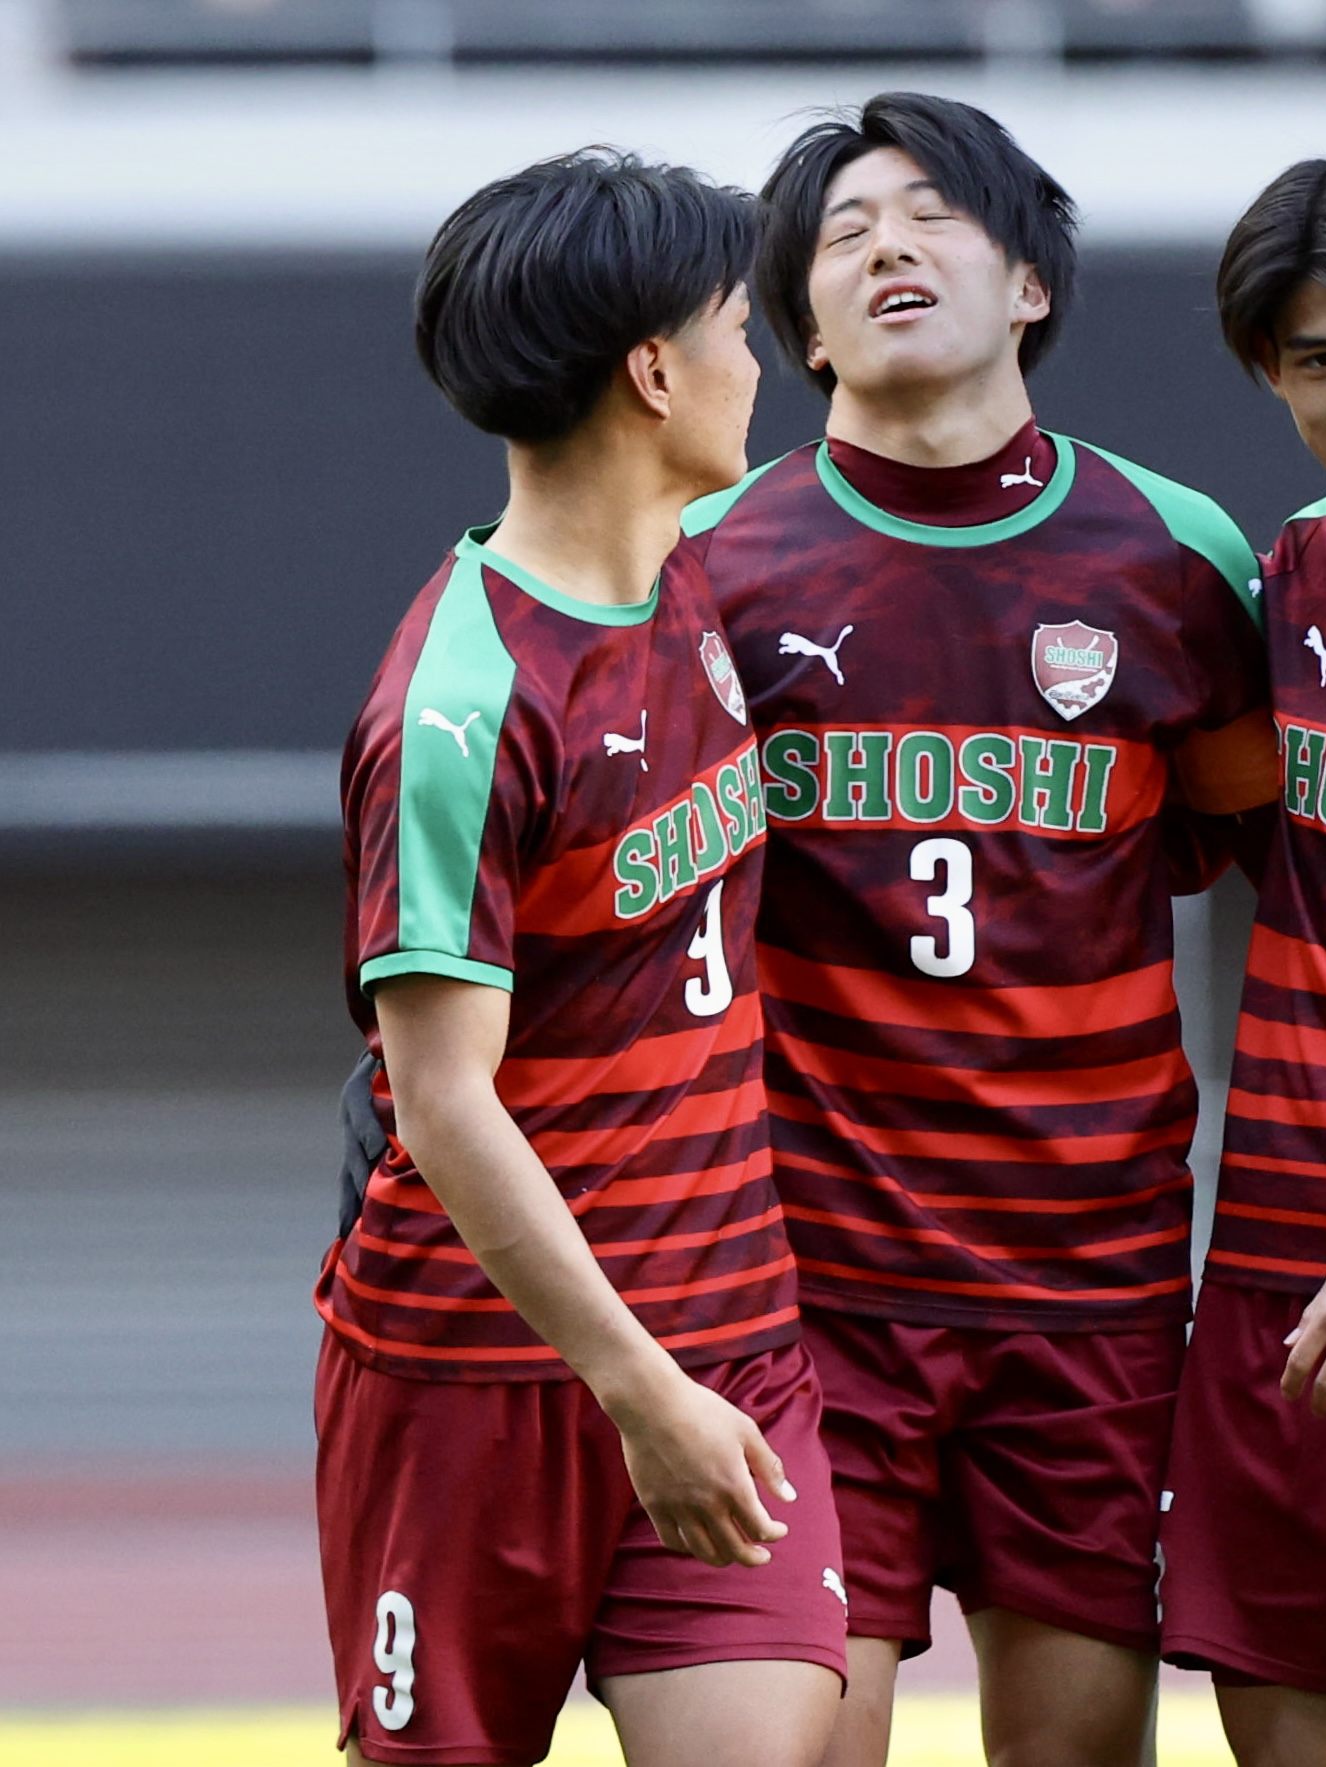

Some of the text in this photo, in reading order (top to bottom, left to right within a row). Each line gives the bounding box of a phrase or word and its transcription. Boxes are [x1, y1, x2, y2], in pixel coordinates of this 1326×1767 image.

[1045, 645, 1103, 668] SHOSHI
[763, 729, 1117, 833] SHOSHI
[909, 837, 975, 978] 3
[372, 1590, 416, 1731] 9
